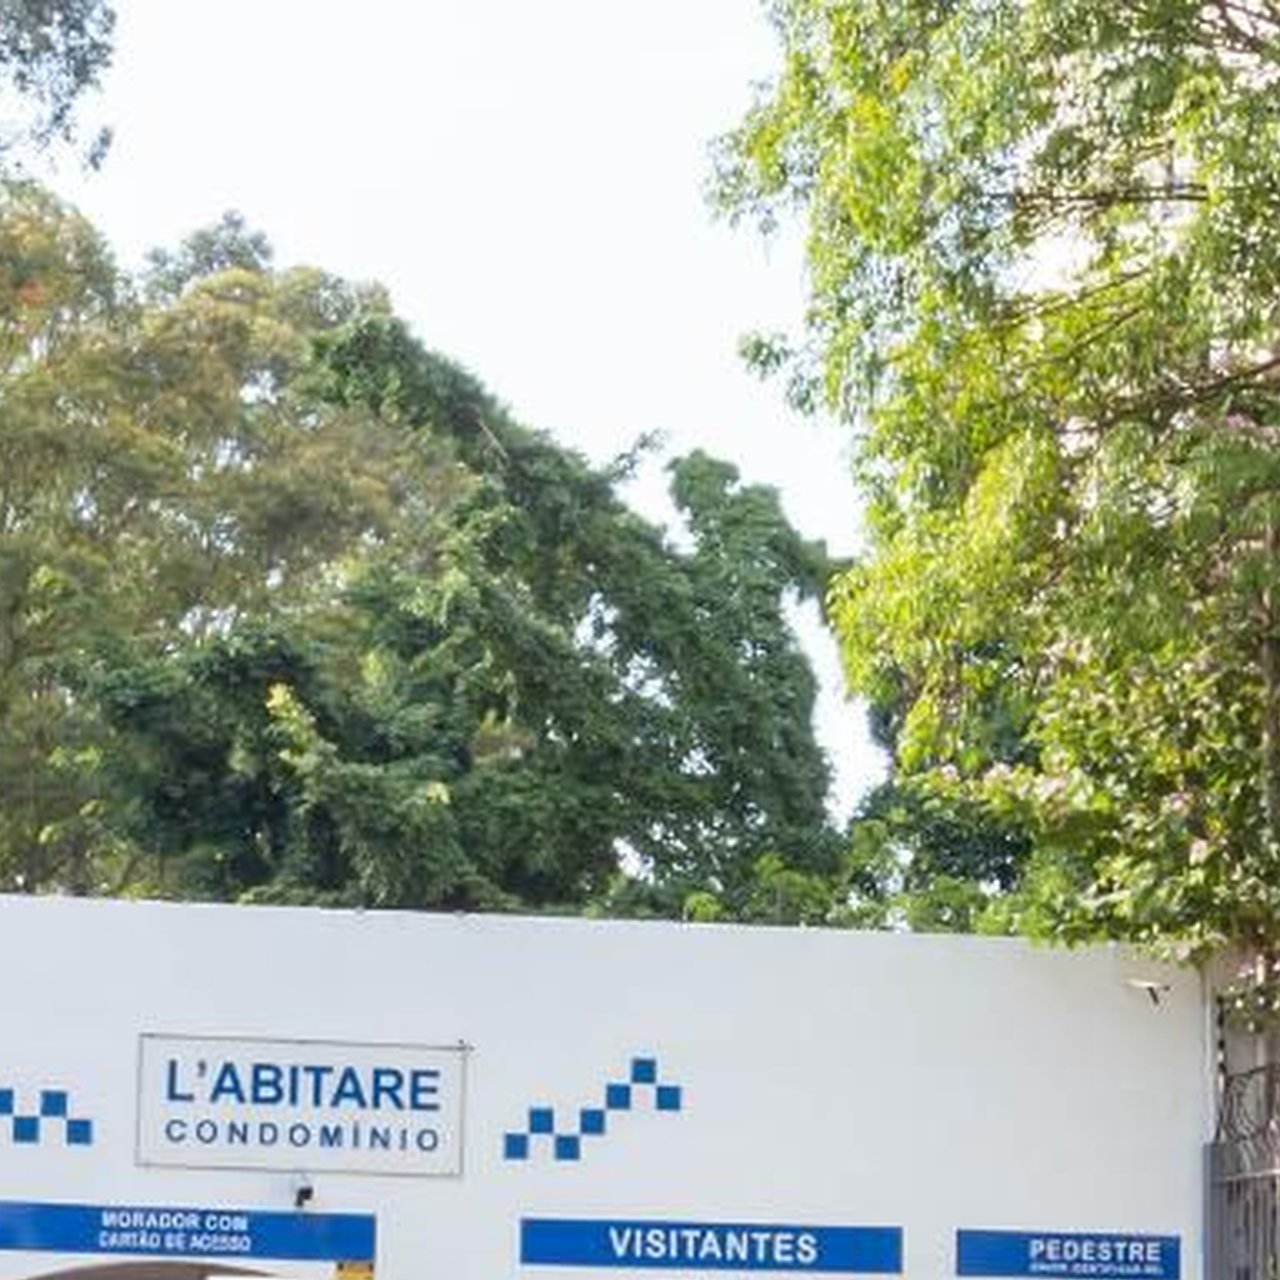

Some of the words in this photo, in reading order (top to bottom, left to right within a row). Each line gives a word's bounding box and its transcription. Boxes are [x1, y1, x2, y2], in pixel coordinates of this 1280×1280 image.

[166, 1059, 441, 1111] L'ABITARE
[165, 1119, 440, 1151] CONDOMÍNIO
[101, 1210, 201, 1230] MORADOR
[205, 1213, 249, 1231] COM
[608, 1226, 819, 1264] VISITANTES
[1029, 1238, 1162, 1262] PEDESTRE
